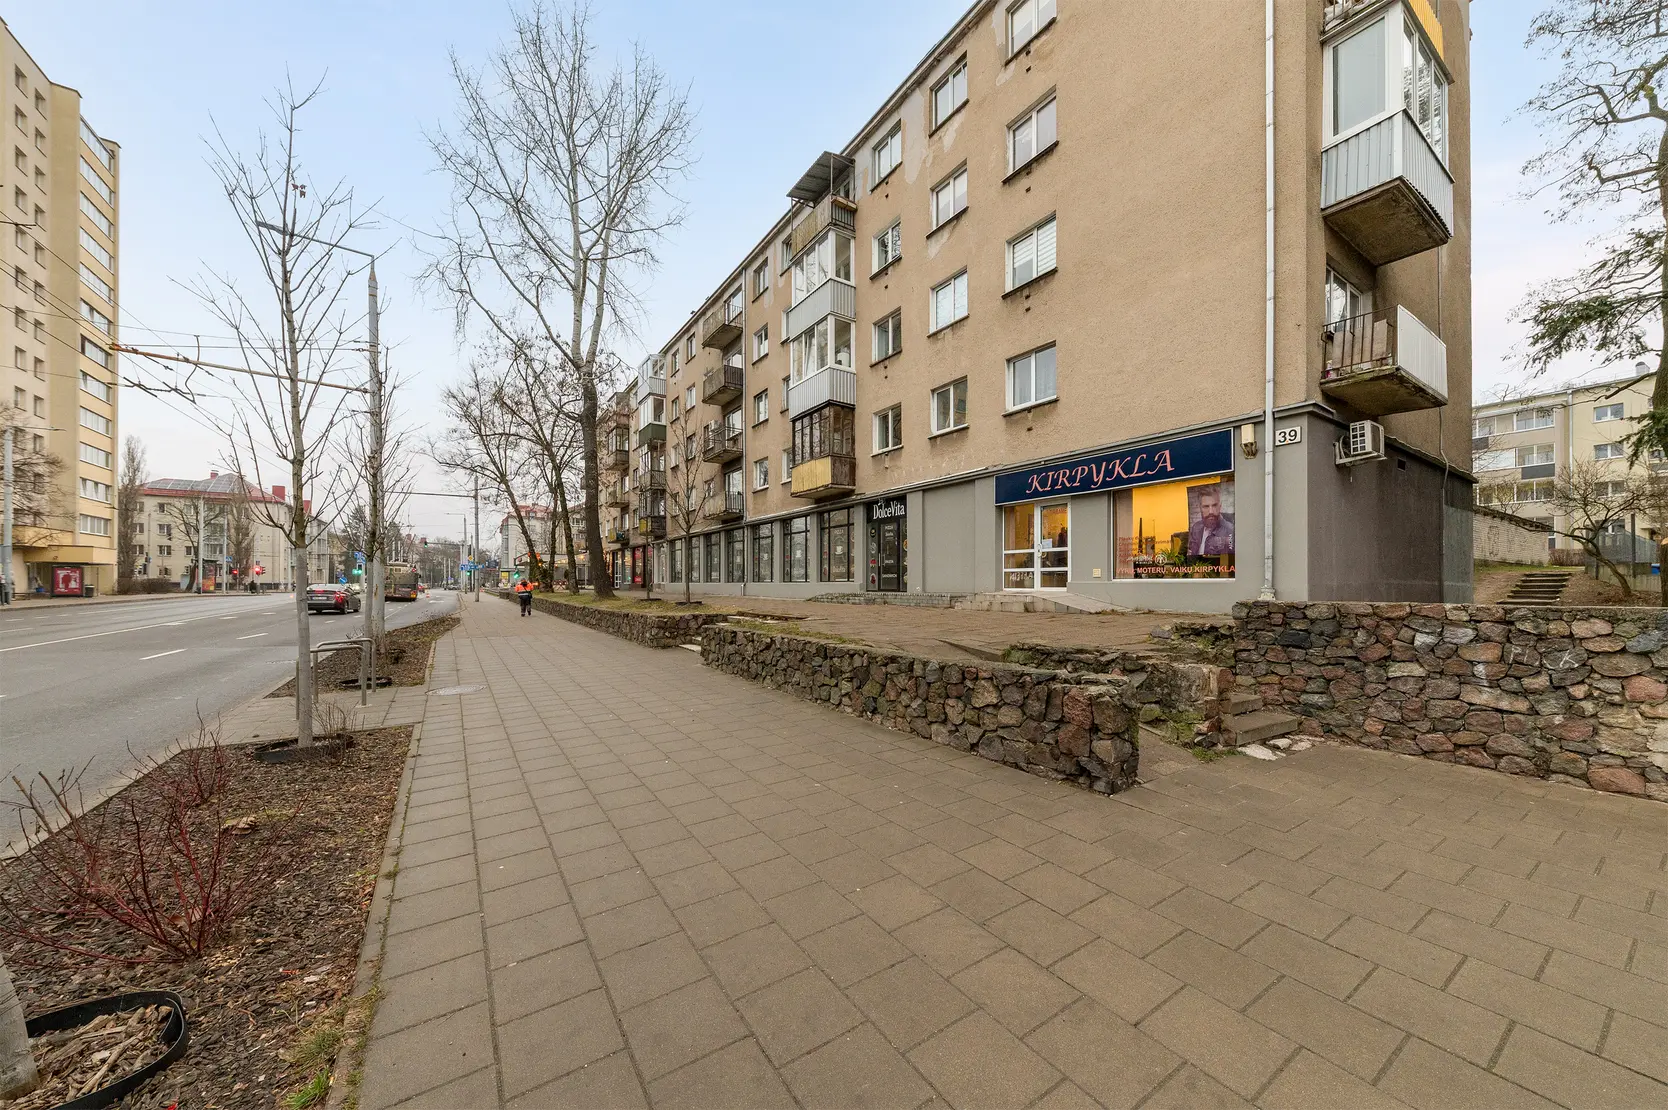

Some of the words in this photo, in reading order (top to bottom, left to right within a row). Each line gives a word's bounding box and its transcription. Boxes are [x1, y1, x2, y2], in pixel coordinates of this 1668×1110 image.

[1278, 428, 1298, 444] 39
[1026, 449, 1175, 495] KIRPYKLA
[873, 501, 905, 519] DolceVita
